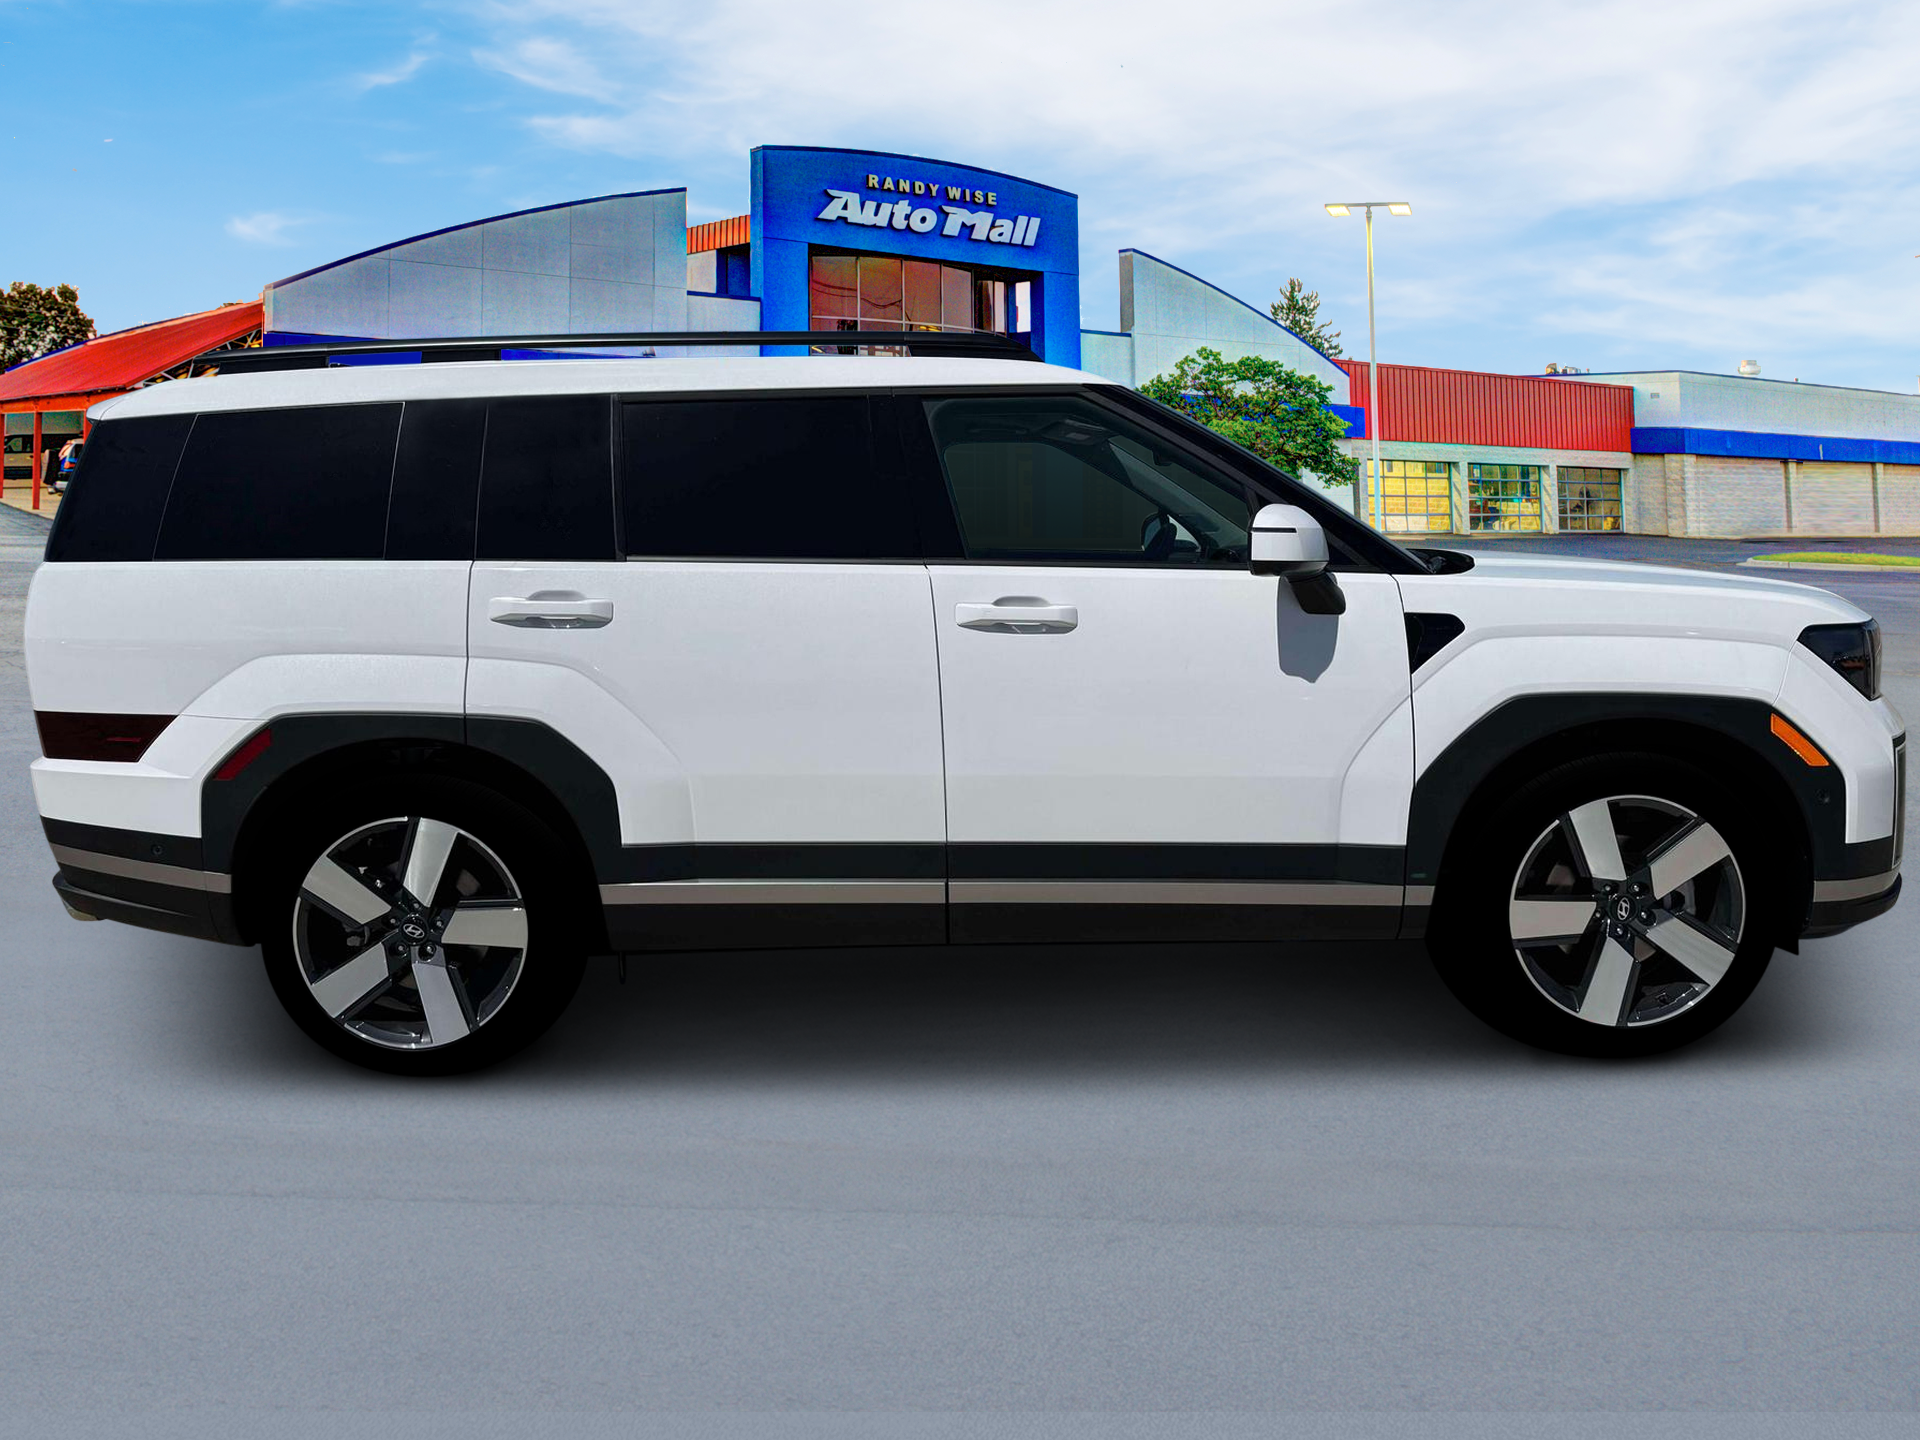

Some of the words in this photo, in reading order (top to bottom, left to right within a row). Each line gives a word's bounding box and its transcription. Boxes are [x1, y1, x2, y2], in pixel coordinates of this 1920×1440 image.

[867, 174, 939, 196] RANDY
[946, 186, 998, 205] WISE
[817, 188, 938, 233] Auto
[940, 205, 1041, 247] Mall
